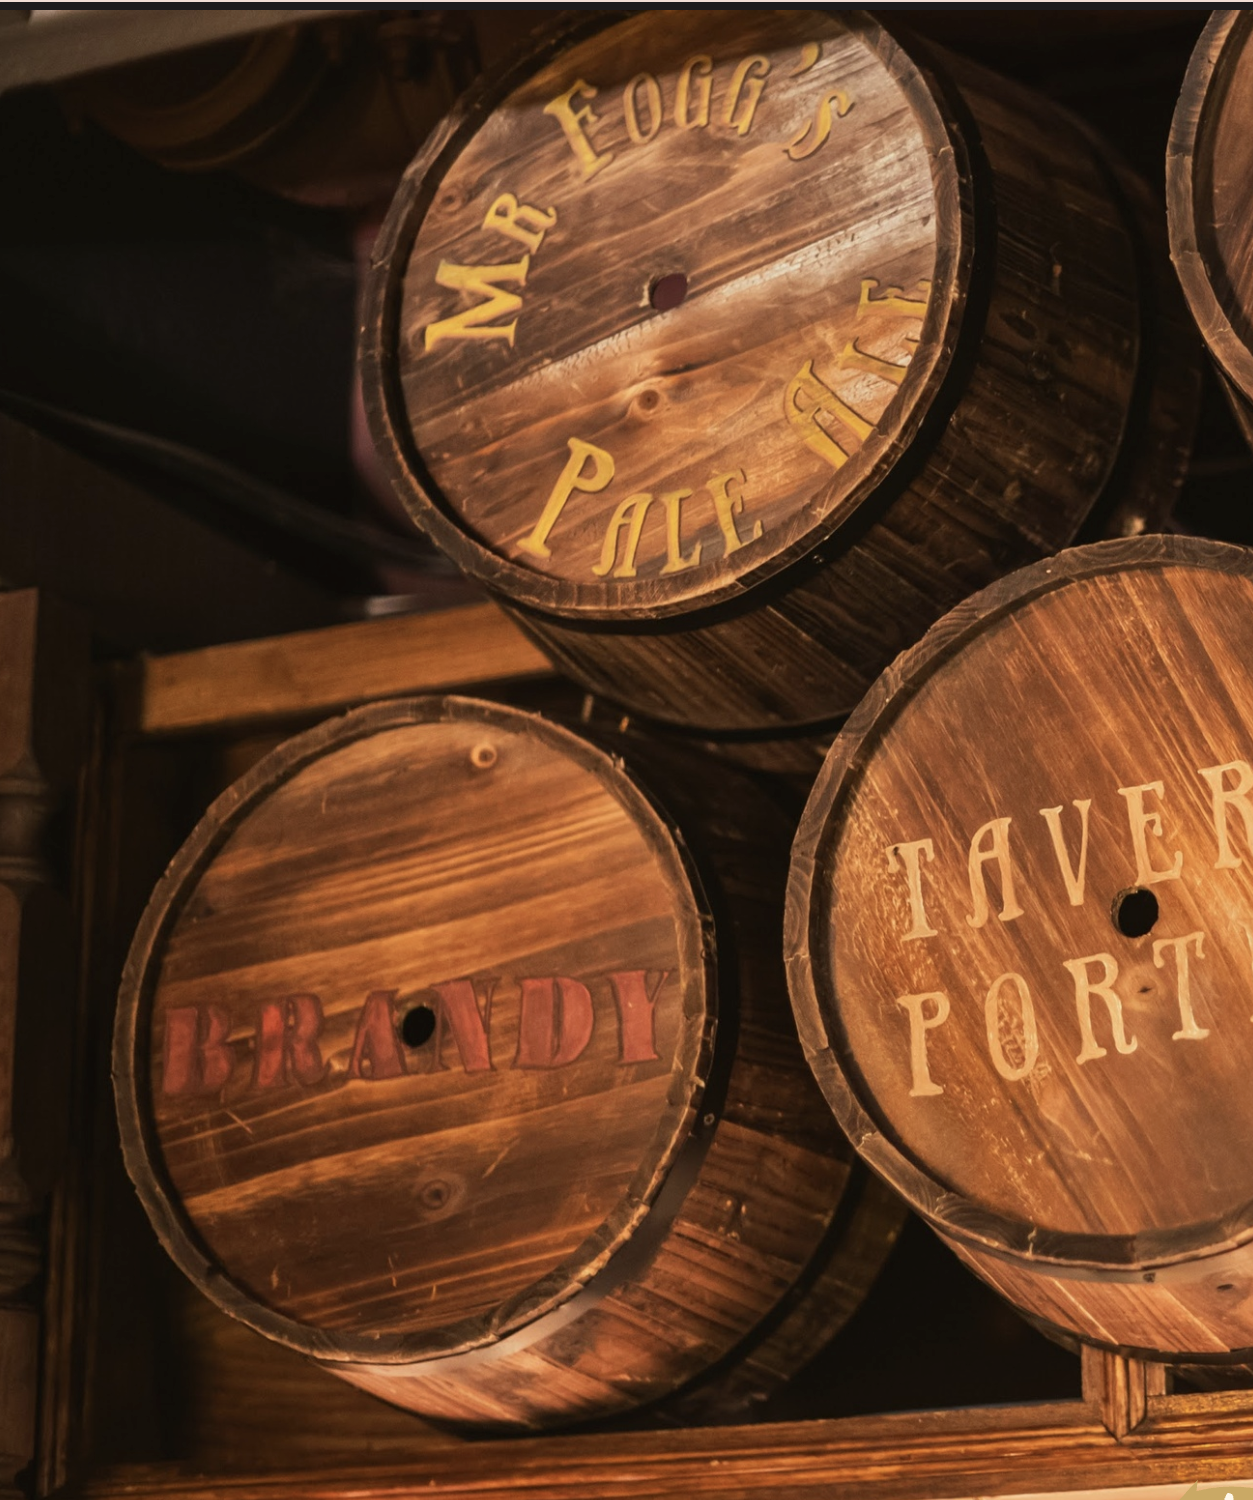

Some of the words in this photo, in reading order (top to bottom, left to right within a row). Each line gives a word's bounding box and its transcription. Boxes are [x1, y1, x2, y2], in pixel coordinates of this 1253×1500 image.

[516, 436, 764, 578] PALE
[783, 278, 932, 471] ALE
[160, 969, 677, 1096] BRANDY
